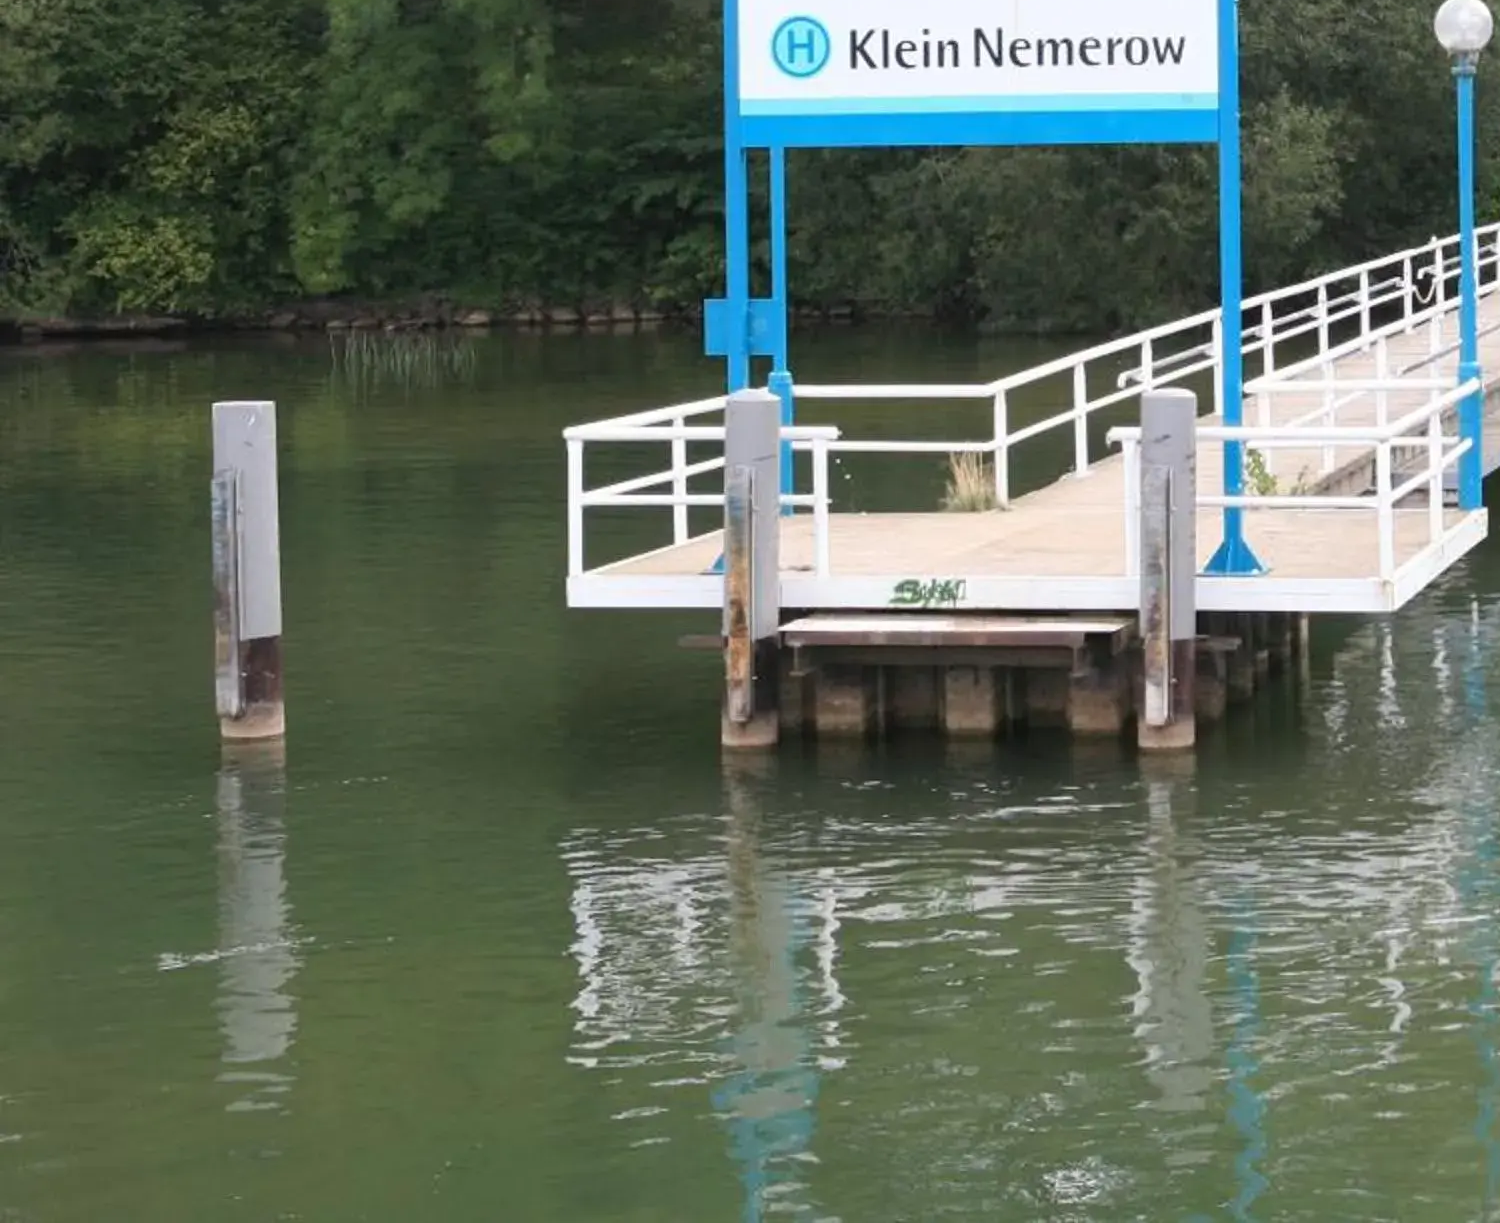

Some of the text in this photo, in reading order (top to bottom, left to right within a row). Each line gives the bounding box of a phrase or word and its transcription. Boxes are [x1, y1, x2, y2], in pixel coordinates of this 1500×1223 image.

[787, 28, 815, 64] H
[850, 26, 1186, 70] Klein Nemerow
